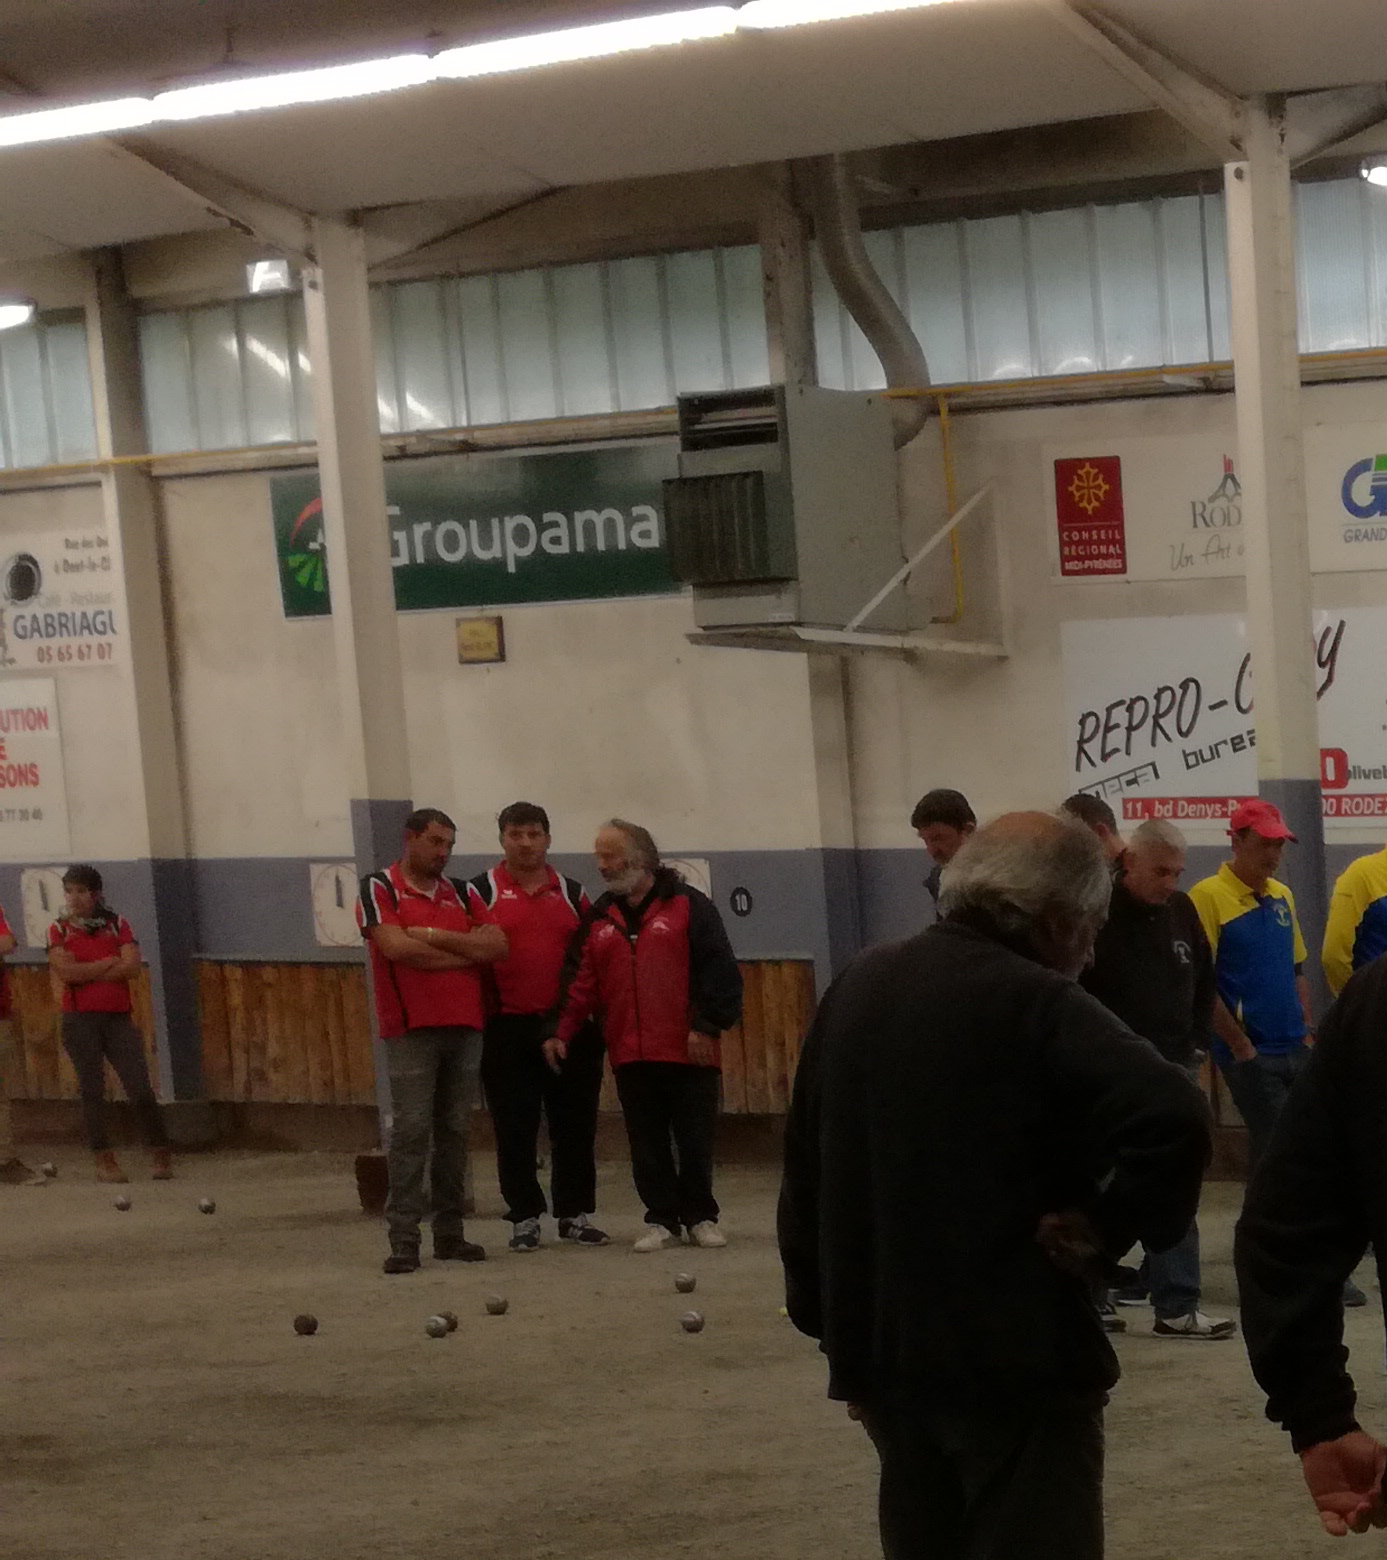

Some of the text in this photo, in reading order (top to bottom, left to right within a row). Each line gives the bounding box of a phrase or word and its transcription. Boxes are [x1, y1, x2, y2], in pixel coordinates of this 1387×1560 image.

[1190, 500, 1242, 530] ROD
[1062, 528, 1122, 542] CONSEIL
[1343, 527, 1387, 543] GRAND
[0, 706, 49, 733] UTION
[0, 762, 40, 789] SONS
[1125, 799, 1241, 820] 11, bd Denys-P
[735, 893, 749, 912] 10
